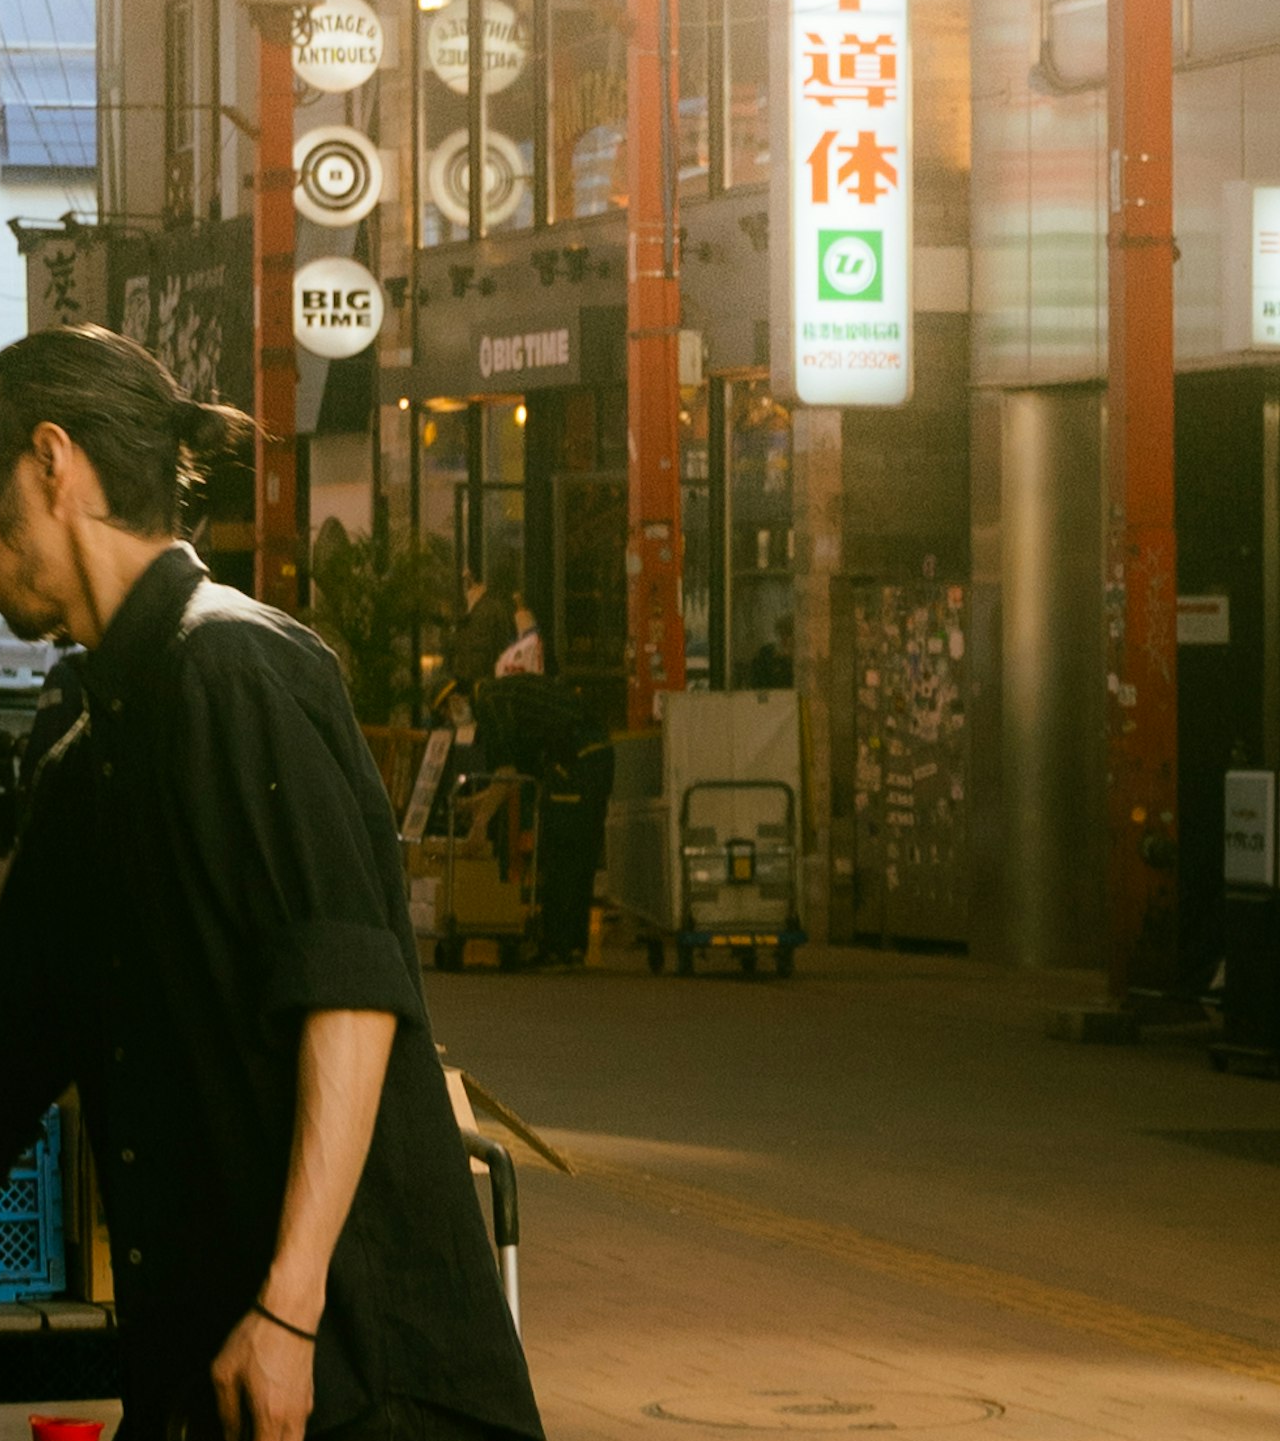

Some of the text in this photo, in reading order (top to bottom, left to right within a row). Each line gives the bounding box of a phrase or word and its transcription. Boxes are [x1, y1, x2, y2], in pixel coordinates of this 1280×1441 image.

[299, 14, 366, 36] NTAGE
[297, 46, 377, 64] ANTIQUES
[301, 288, 372, 311] BIG
[302, 312, 372, 328] TIME
[493, 327, 570, 373] BIG TIME
